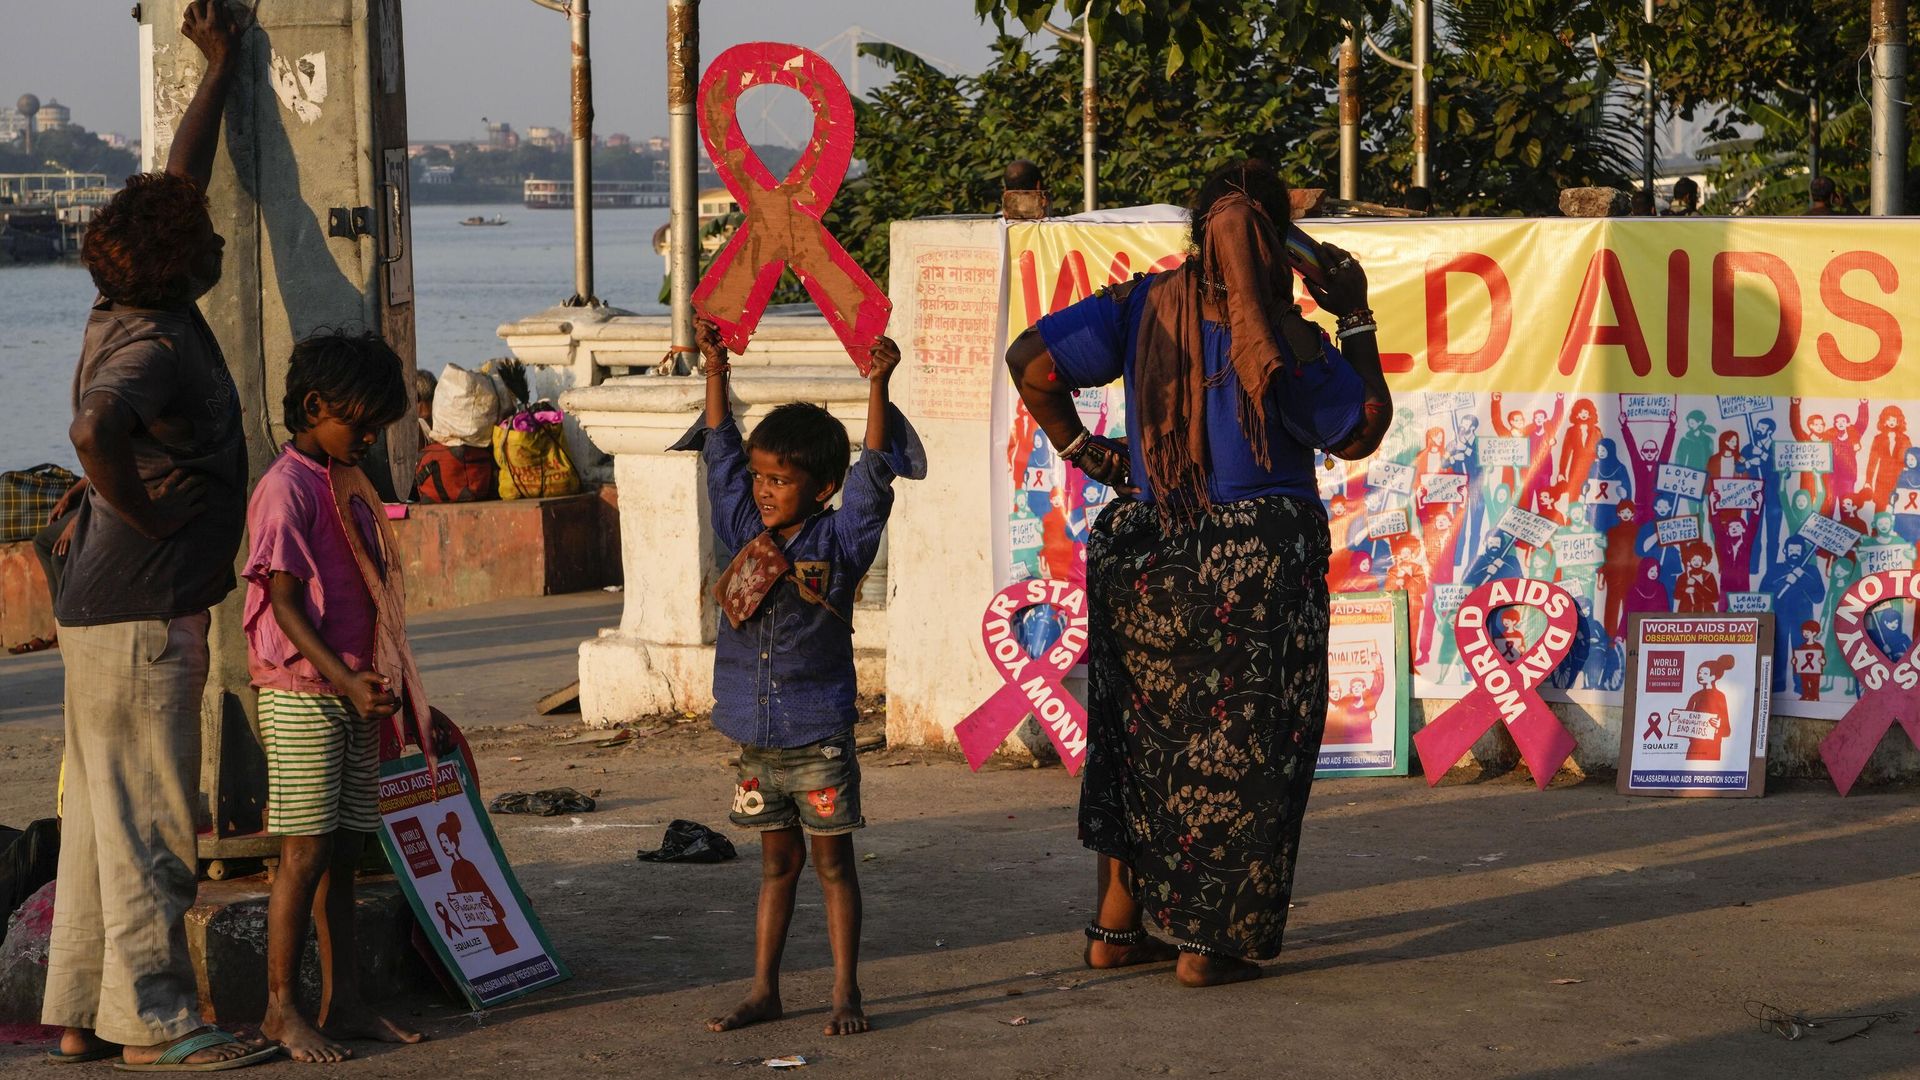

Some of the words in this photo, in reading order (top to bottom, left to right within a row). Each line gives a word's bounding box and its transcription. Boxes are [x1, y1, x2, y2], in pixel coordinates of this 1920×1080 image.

[920, 264, 945, 281] রাম
[1557, 248, 1903, 381] AIDS
[1628, 397, 1646, 407] SAVE
[1646, 396, 1671, 407] LIVES:
[1784, 444, 1820, 454] SCHOOL
[1666, 468, 1698, 481] LOVE
[1664, 482, 1696, 495] LOVE
[1722, 482, 1738, 492] LET
[1734, 498, 1753, 507] LEAD
[1012, 522, 1033, 535] FIGHT
[1388, 522, 1407, 532] FEES
[1661, 531, 1678, 544] END
[1680, 528, 1698, 541] FEES
[1563, 538, 1593, 550] FIGHT
[1563, 550, 1594, 561] RACISM
[1869, 548, 1901, 561] FIGHT
[1869, 560, 1903, 573] RACISM
[1488, 578, 1570, 619] AIDS
[1836, 576, 1884, 625] NO
[1334, 604, 1362, 615] AIDS
[1366, 602, 1389, 614] DAY
[1646, 624, 1693, 633] WORLD
[1696, 624, 1725, 633] AIDS
[1729, 623, 1754, 633] DAY
[986, 594, 1030, 681] YOUR
[1645, 634, 1697, 643] OBSERVATION
[1698, 634, 1736, 642] PROGRAM
[1737, 634, 1753, 642] 2022
[1328, 648, 1370, 666] QUALIZE!
[1516, 624, 1572, 691] DAY
[1654, 658, 1678, 667] WORLD
[1836, 630, 1890, 691] SAY
[1458, 604, 1528, 725] WORLD
[1650, 668, 1666, 676] AIDS
[1668, 668, 1681, 676] DAY
[1020, 676, 1087, 758] KNOW
[1676, 725, 1690, 733] END
[1320, 756, 1330, 765] AND
[1330, 756, 1341, 765] AIDS
[411, 774, 433, 790] AIDS
[1634, 774, 1669, 784] THALASSAEMIA
[1670, 776, 1681, 784] AND
[1681, 775, 1693, 784] AIDS
[1694, 775, 1724, 784] PREVENTION
[1724, 774, 1745, 784] SOCIETY
[418, 785, 447, 802] PROGAM
[400, 829, 421, 843] WORLD
[454, 937, 482, 952] EQUALIZE
